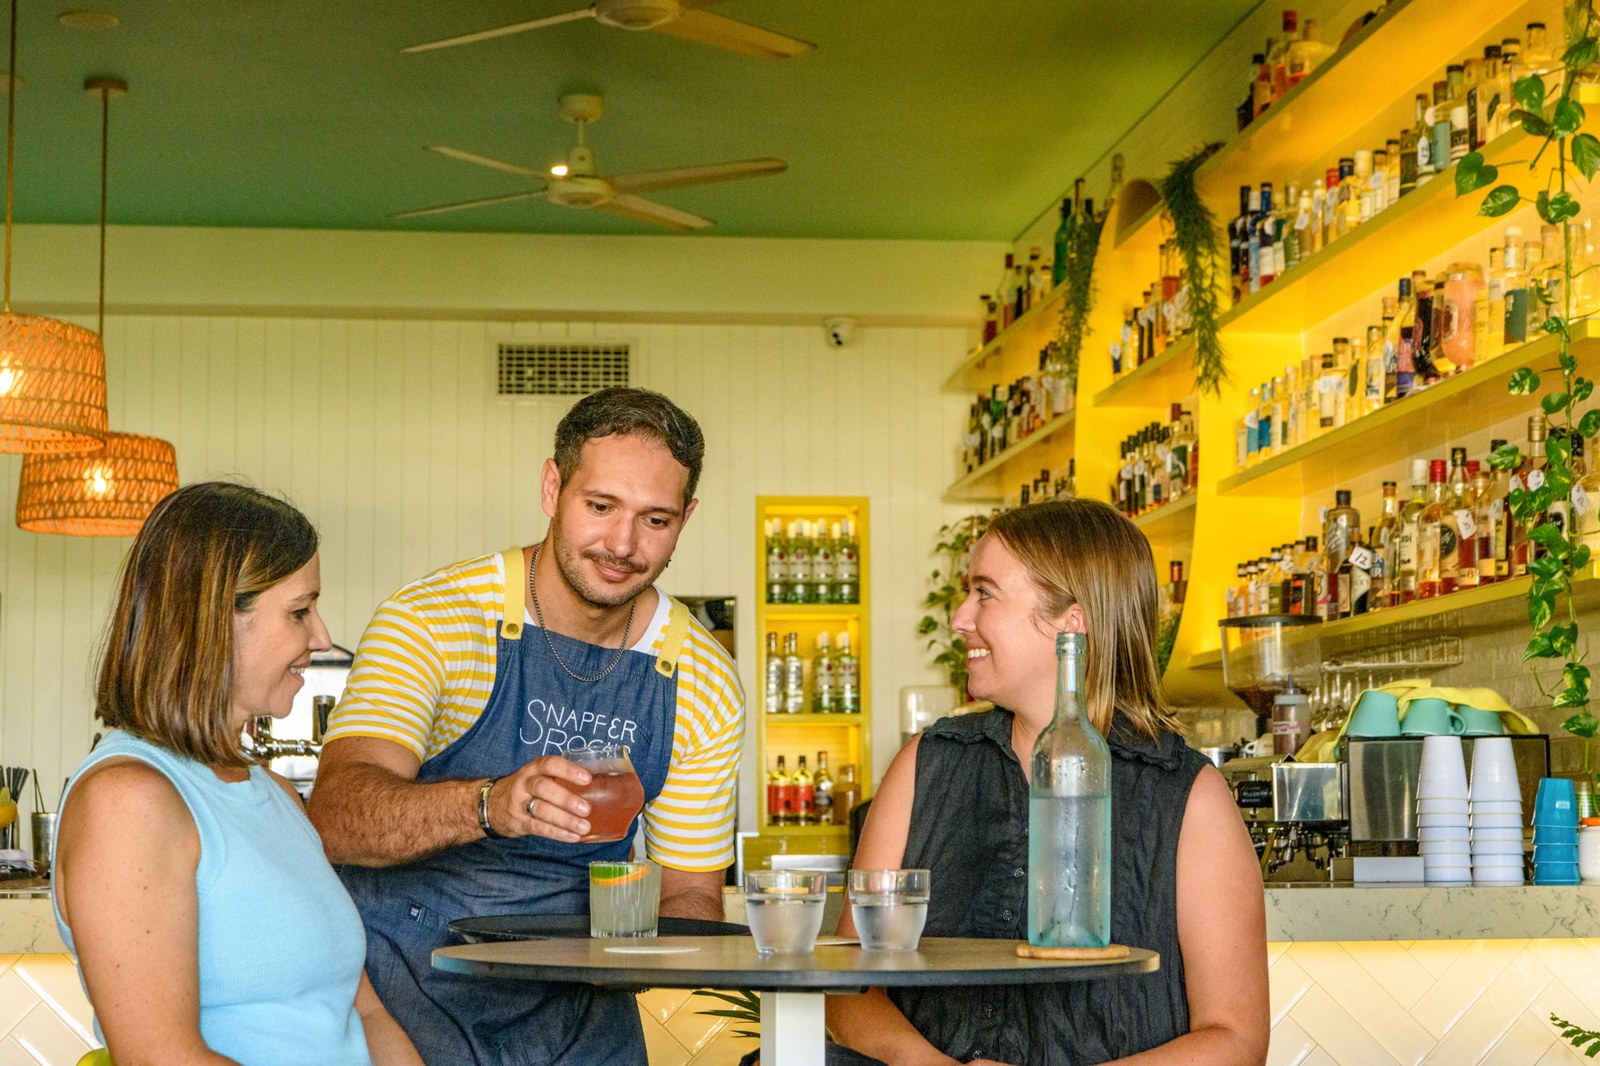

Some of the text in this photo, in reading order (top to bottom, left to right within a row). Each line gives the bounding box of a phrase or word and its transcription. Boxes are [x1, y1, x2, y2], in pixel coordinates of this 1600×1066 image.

[1354, 553, 1368, 566] 12
[519, 699, 637, 744] SNAPPER
[542, 727, 632, 758] ROC
